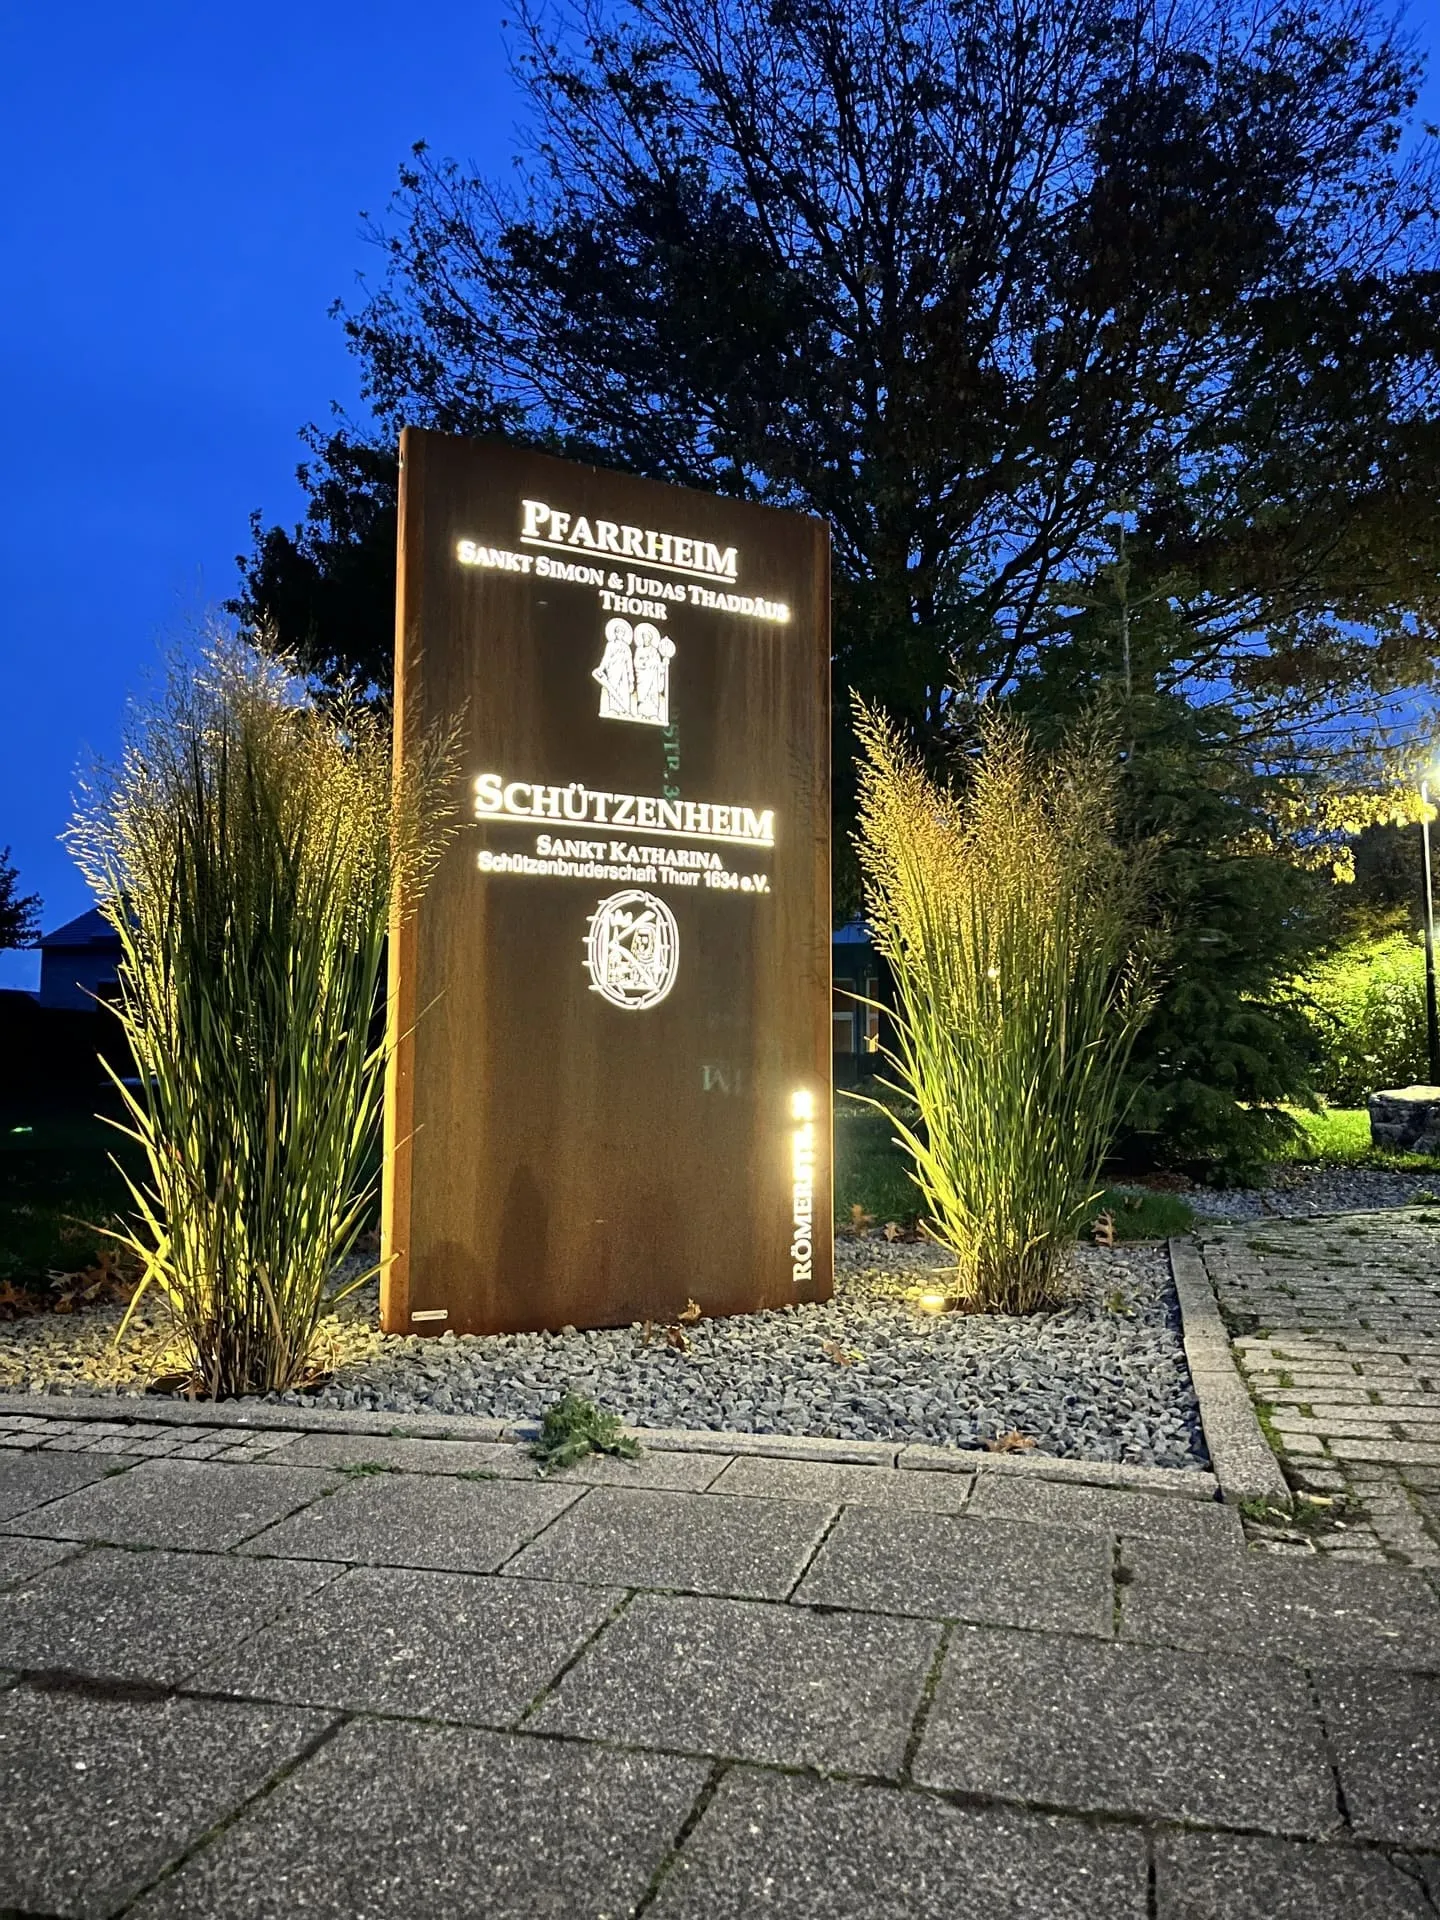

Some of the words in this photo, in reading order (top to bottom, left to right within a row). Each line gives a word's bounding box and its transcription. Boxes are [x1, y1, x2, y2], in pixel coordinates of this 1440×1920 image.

[521, 499, 739, 577] PFARRHEIM
[458, 540, 533, 573] SANKT
[535, 555, 604, 587] SIMON
[607, 572, 624, 591] &
[626, 572, 687, 602] JUDAS
[598, 589, 668, 620] THORR
[474, 773, 775, 840] SCHÜTZENHEIM
[477, 850, 658, 883] Schützenbruderschaft
[658, 866, 700, 886] Thorr
[703, 870, 739, 890] 1634
[740, 873, 771, 894] e.V.
[536, 834, 607, 860] SANKT
[609, 840, 724, 871] KATHARINA
